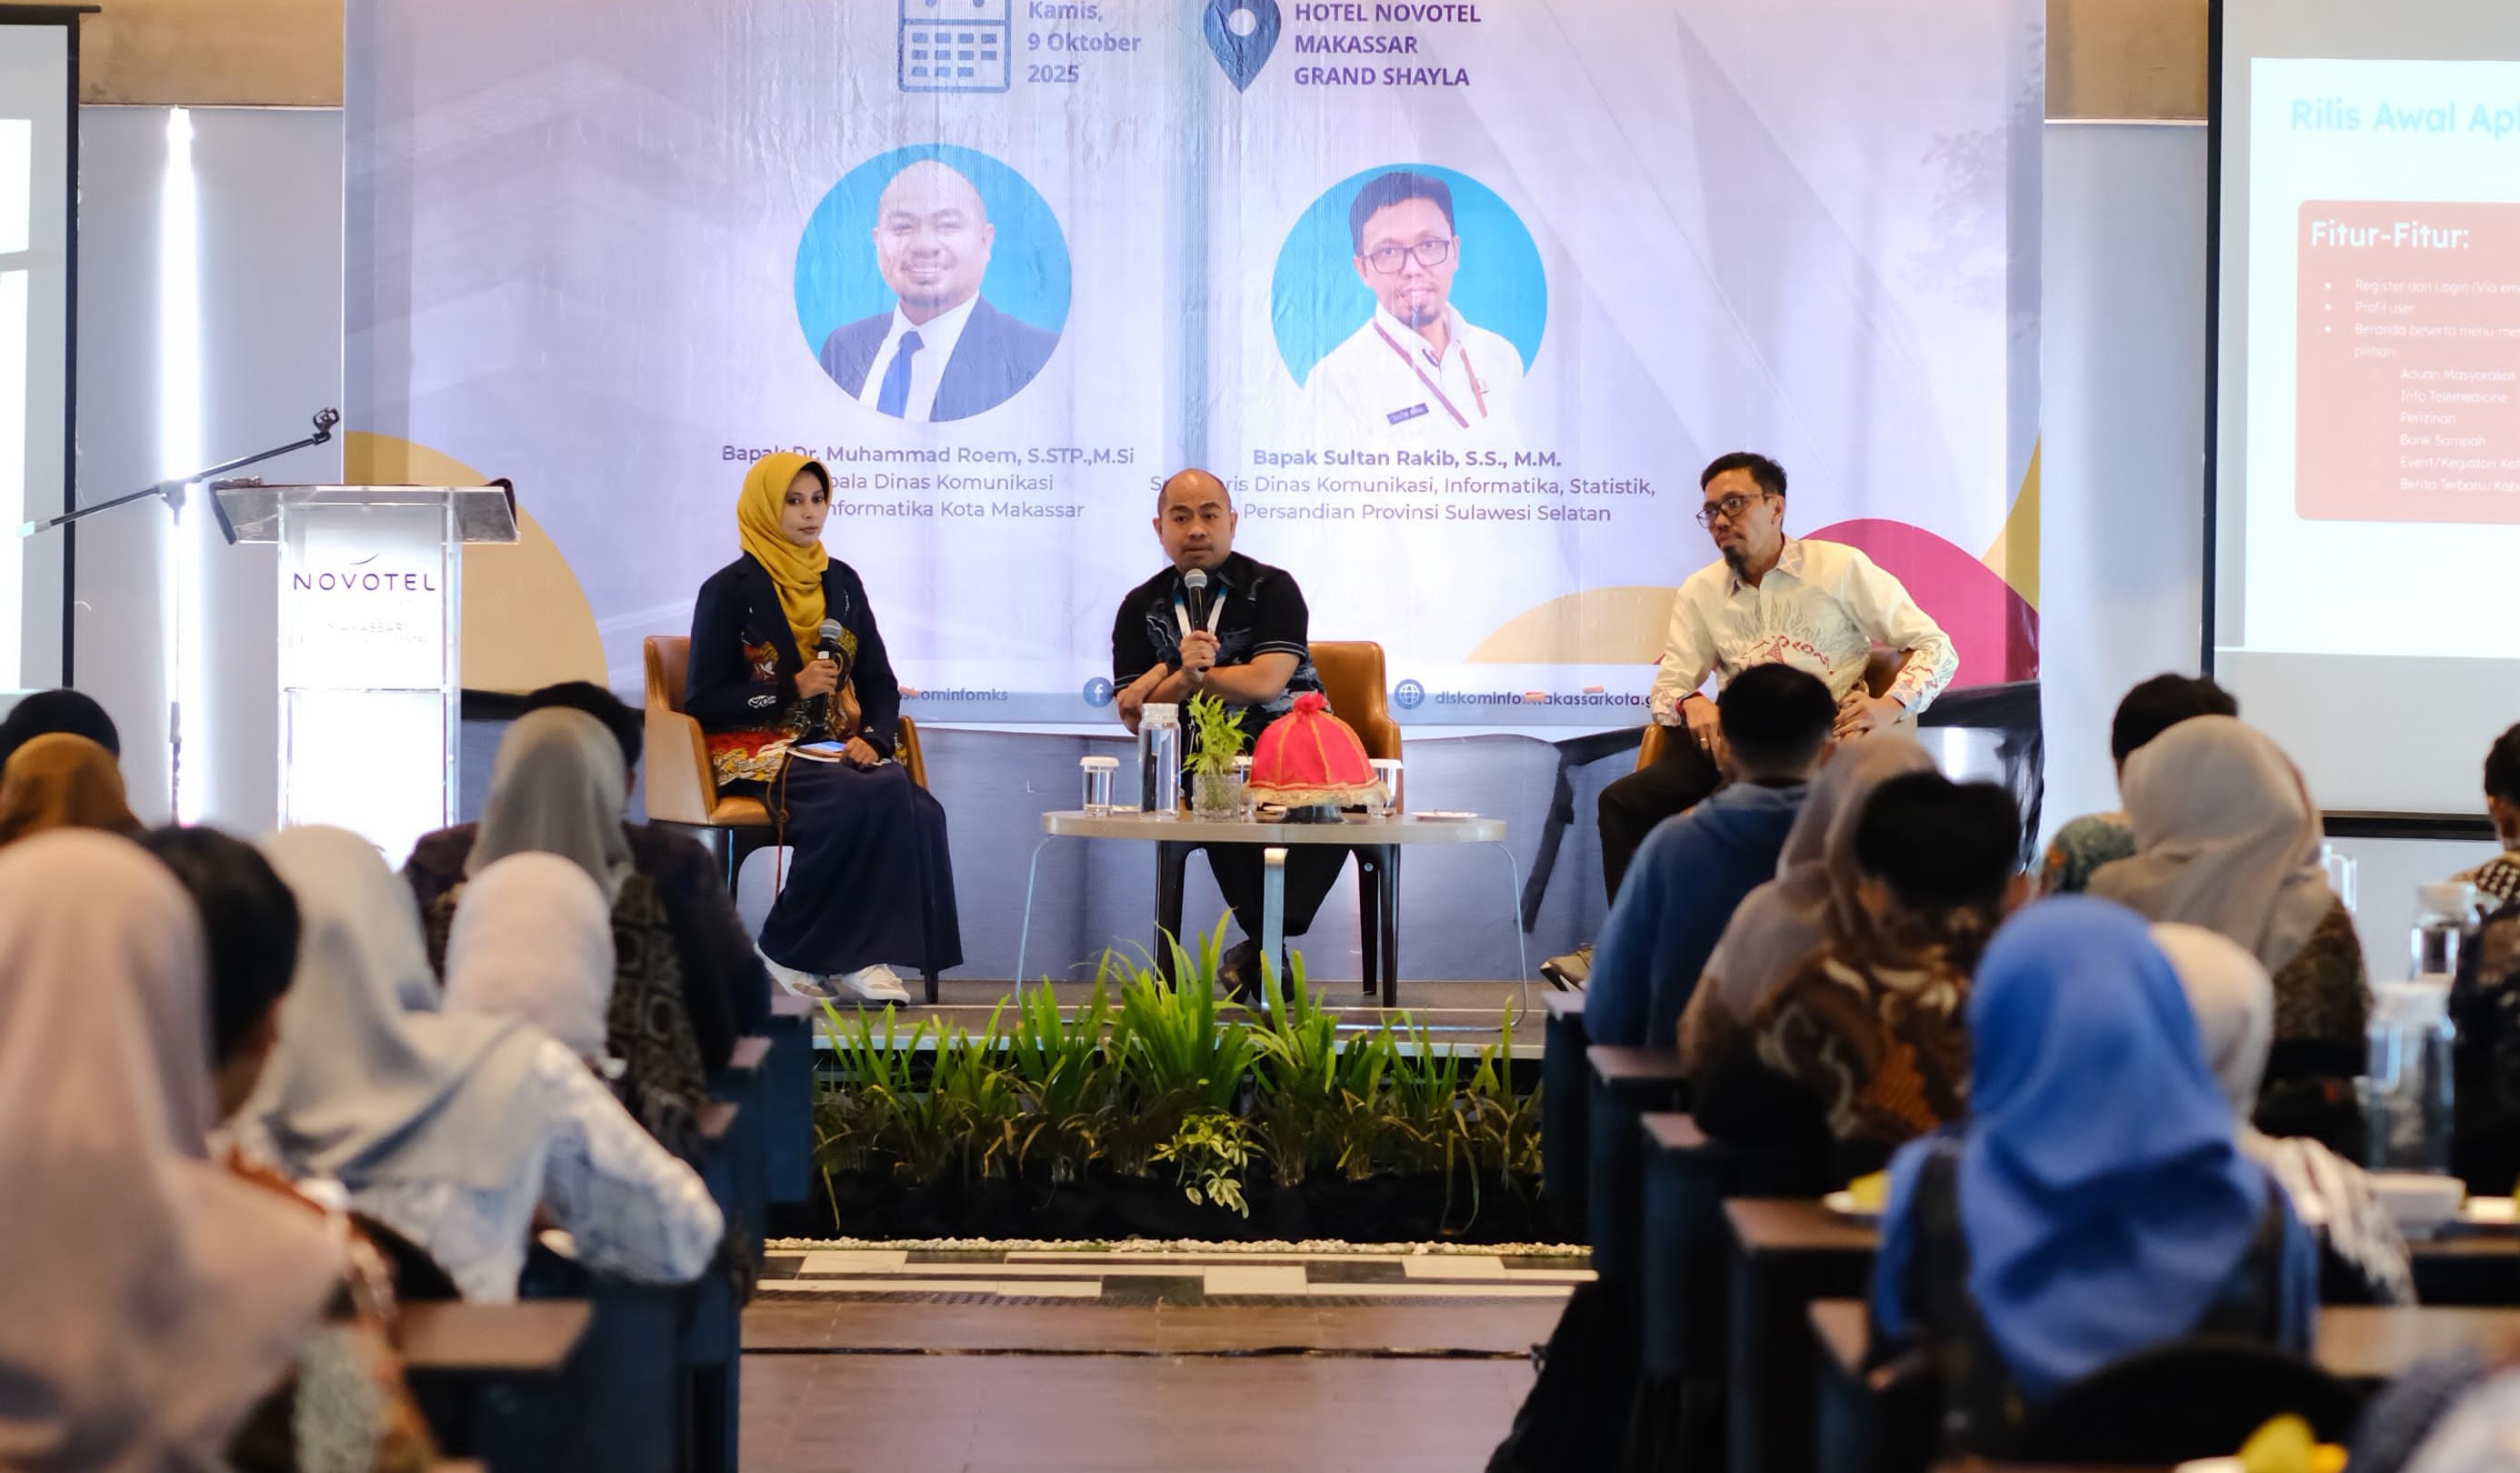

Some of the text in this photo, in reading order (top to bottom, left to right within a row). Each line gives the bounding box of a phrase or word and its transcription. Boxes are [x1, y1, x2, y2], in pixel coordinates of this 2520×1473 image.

[1028, 1, 1103, 22] Kamis,
[1295, 4, 1482, 23] HOTEL NOVOTEL
[1027, 31, 1141, 53] 9 Oktober
[1295, 35, 1418, 55] MAKASSAR
[1028, 64, 1080, 83] 2025
[1295, 66, 1470, 86] GRAND SHAYLA
[2292, 97, 2361, 130] Rilis
[2374, 102, 2455, 132] Awal
[2312, 220, 2470, 249] Fitur-Fitur:
[2355, 279, 2404, 295] Register
[2444, 369, 2515, 384] Masyarakat
[2401, 390, 2508, 404] Info Telemedicine
[2400, 434, 2485, 448] Bank Sampah
[827, 446, 950, 463] Muhammad
[957, 447, 1021, 466] Roem,
[1027, 447, 1135, 465] S.STP.,M.Si
[1254, 450, 1562, 470] Bapak Sultan Rakib, S.S., M.M.
[875, 472, 931, 489] Dinas
[937, 474, 1054, 491] Komunikasi
[1255, 476, 1309, 494] Dinas
[1317, 476, 1438, 496] Komunikasi,
[1445, 477, 1564, 496] Informatika,
[1570, 477, 1655, 498] Statistik,
[2400, 477, 2436, 490] Berita
[829, 499, 1084, 518] nformatika Kota Makassar
[1244, 503, 1611, 522] Persandian Provinsi Sulawesi Selatan
[294, 573, 435, 591] NOVOTEL
